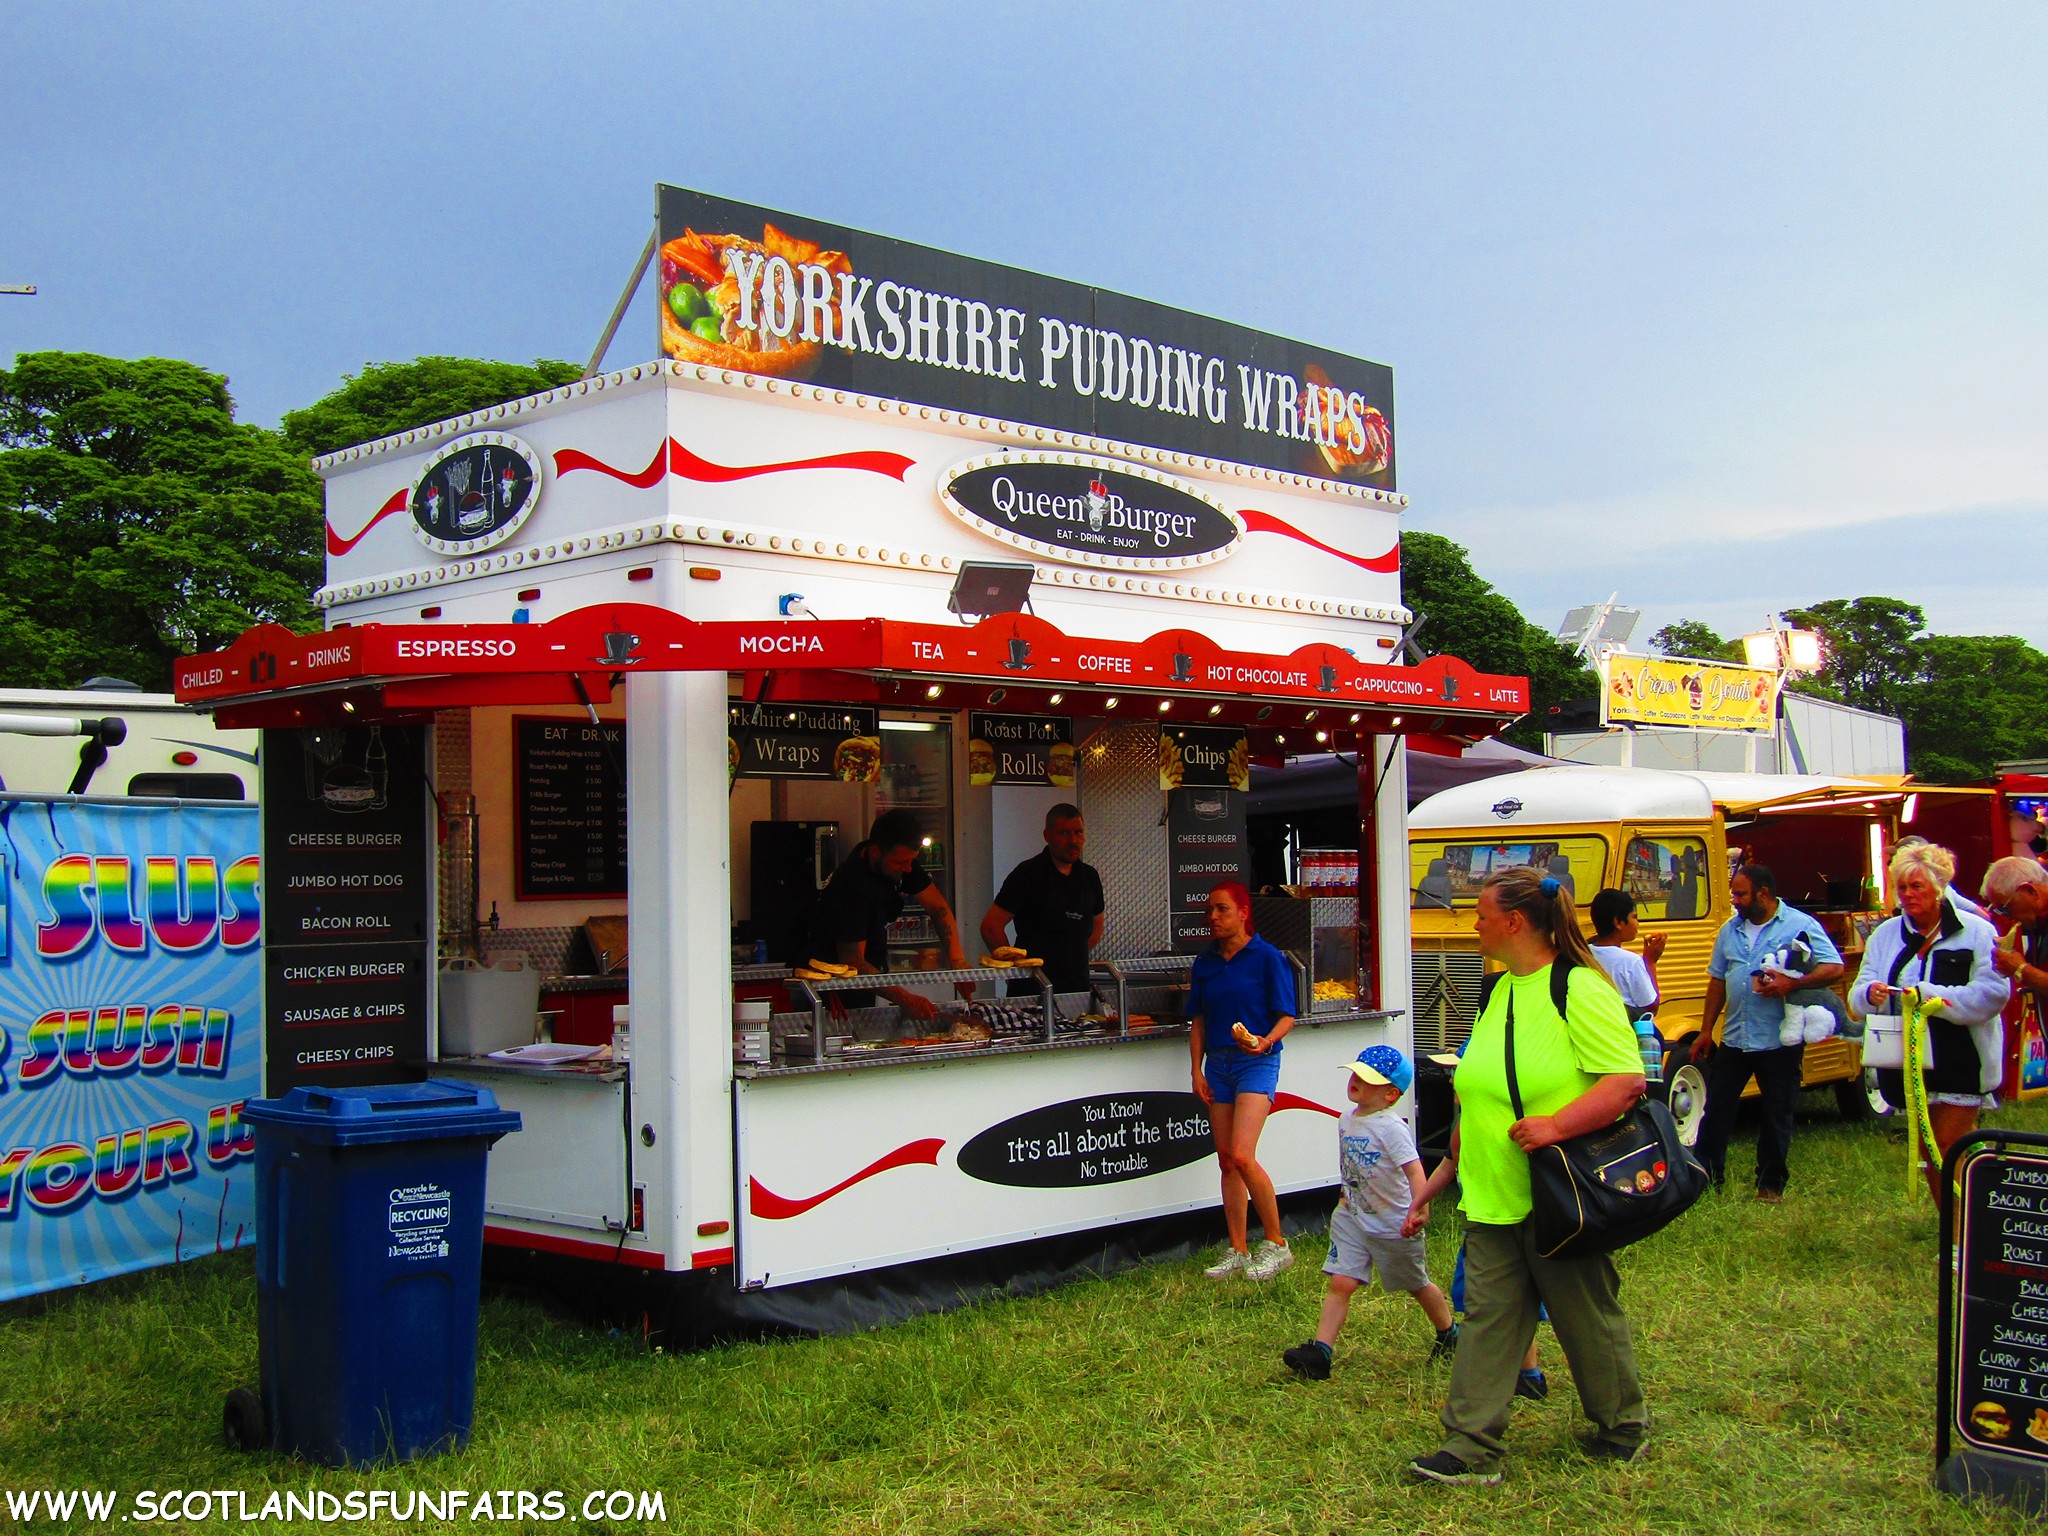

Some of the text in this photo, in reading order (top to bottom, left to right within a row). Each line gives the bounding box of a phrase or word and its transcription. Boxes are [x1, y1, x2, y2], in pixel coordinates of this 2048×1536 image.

[726, 248, 1366, 455] YORKSHIRE PUDDING WRAPS
[991, 476, 1196, 548] Queen Burger
[1057, 529, 1073, 540] EAT
[1080, 532, 1106, 545] DRINK
[1113, 537, 1140, 550] ENJOY
[397, 636, 825, 657] ESPRESSO MOCHA
[182, 646, 351, 689] CHILLED DRINKS
[912, 642, 1519, 703] TEA COFFEE HOT CHOCOLATE CAPPUCCINO LATTE
[798, 711, 861, 736] Pudding
[984, 719, 1060, 740] Roast Pork
[544, 727, 619, 742] EAT DRNK
[754, 737, 820, 769] Wraps
[1184, 744, 1226, 771] Chips
[1001, 752, 1045, 775] Rolls
[288, 833, 402, 845] CHEESE BURGER
[1177, 834, 1237, 844] CHEESE BURGER
[1178, 863, 1239, 874] JUMBO HOT DOG
[287, 874, 403, 887] JUMBO HOT DOG
[301, 916, 391, 930] BACON ROLL
[283, 962, 405, 980] CHICKEN BURGER
[284, 1003, 405, 1023] SAUSAGE & CHIPS
[18, 1003, 233, 1084] SLUSH
[296, 1045, 394, 1064] CHEESY CHIPS
[1083, 1102, 1143, 1122] You Know
[1008, 1113, 1211, 1163] It's all about the taste
[1080, 1153, 1148, 1179] No trouble
[2003, 1167, 2048, 1185] JUMBO
[1988, 1191, 2031, 1209] BACON
[391, 1206, 448, 1223] RECYCLING
[388, 1241, 438, 1257] Newcastle
[2003, 1243, 2042, 1262] ROAST
[1993, 1324, 2048, 1346] SAUSAGE
[1979, 1349, 2020, 1368] CURRY
[1983, 1375, 2010, 1390] HOT
[2019, 1378, 2028, 1394] &
